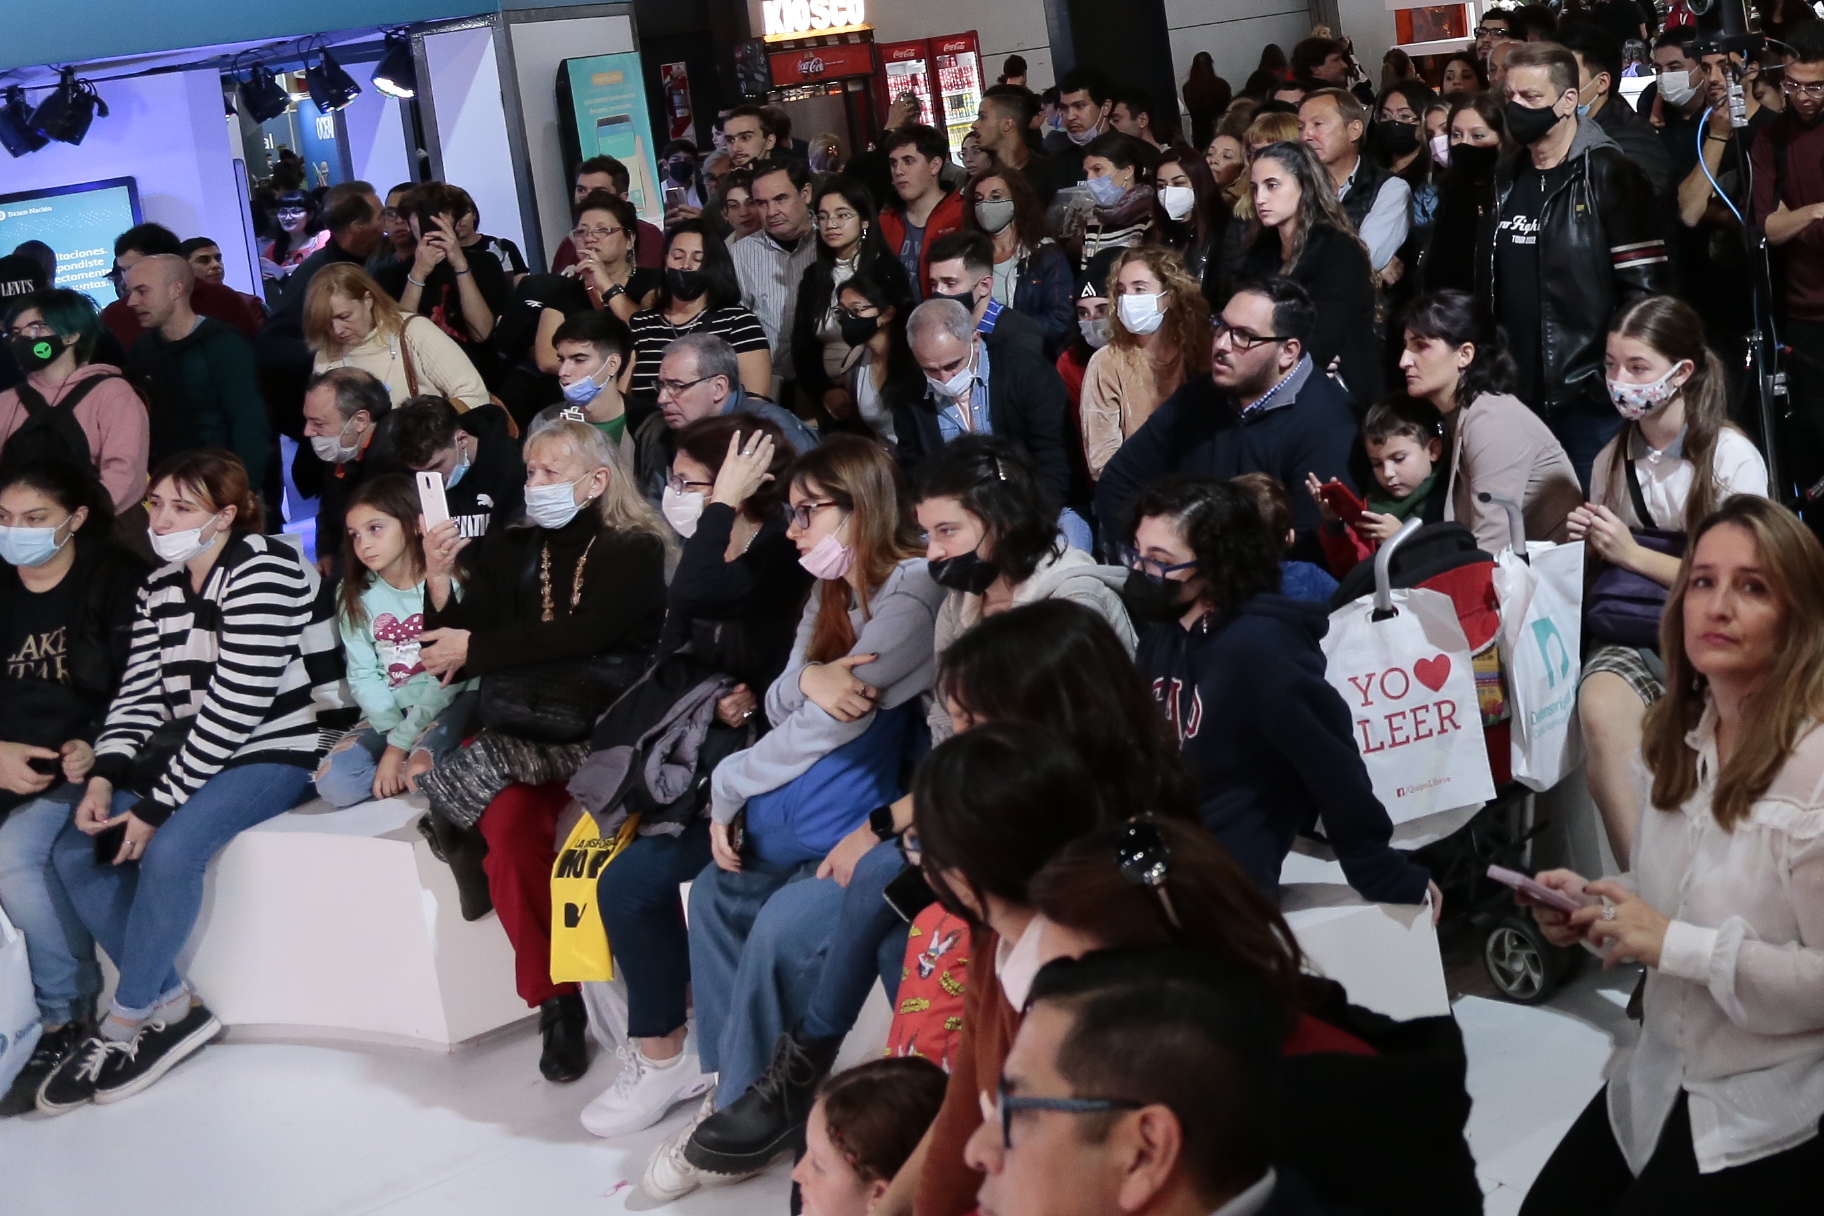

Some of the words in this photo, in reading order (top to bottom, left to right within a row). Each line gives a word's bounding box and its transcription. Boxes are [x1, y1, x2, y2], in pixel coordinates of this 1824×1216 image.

[8, 209, 29, 218] Banco
[29, 205, 53, 215] Nación
[56, 257, 105, 276] pondiste
[1347, 666, 1411, 708] YO
[1356, 699, 1462, 756] LEER
